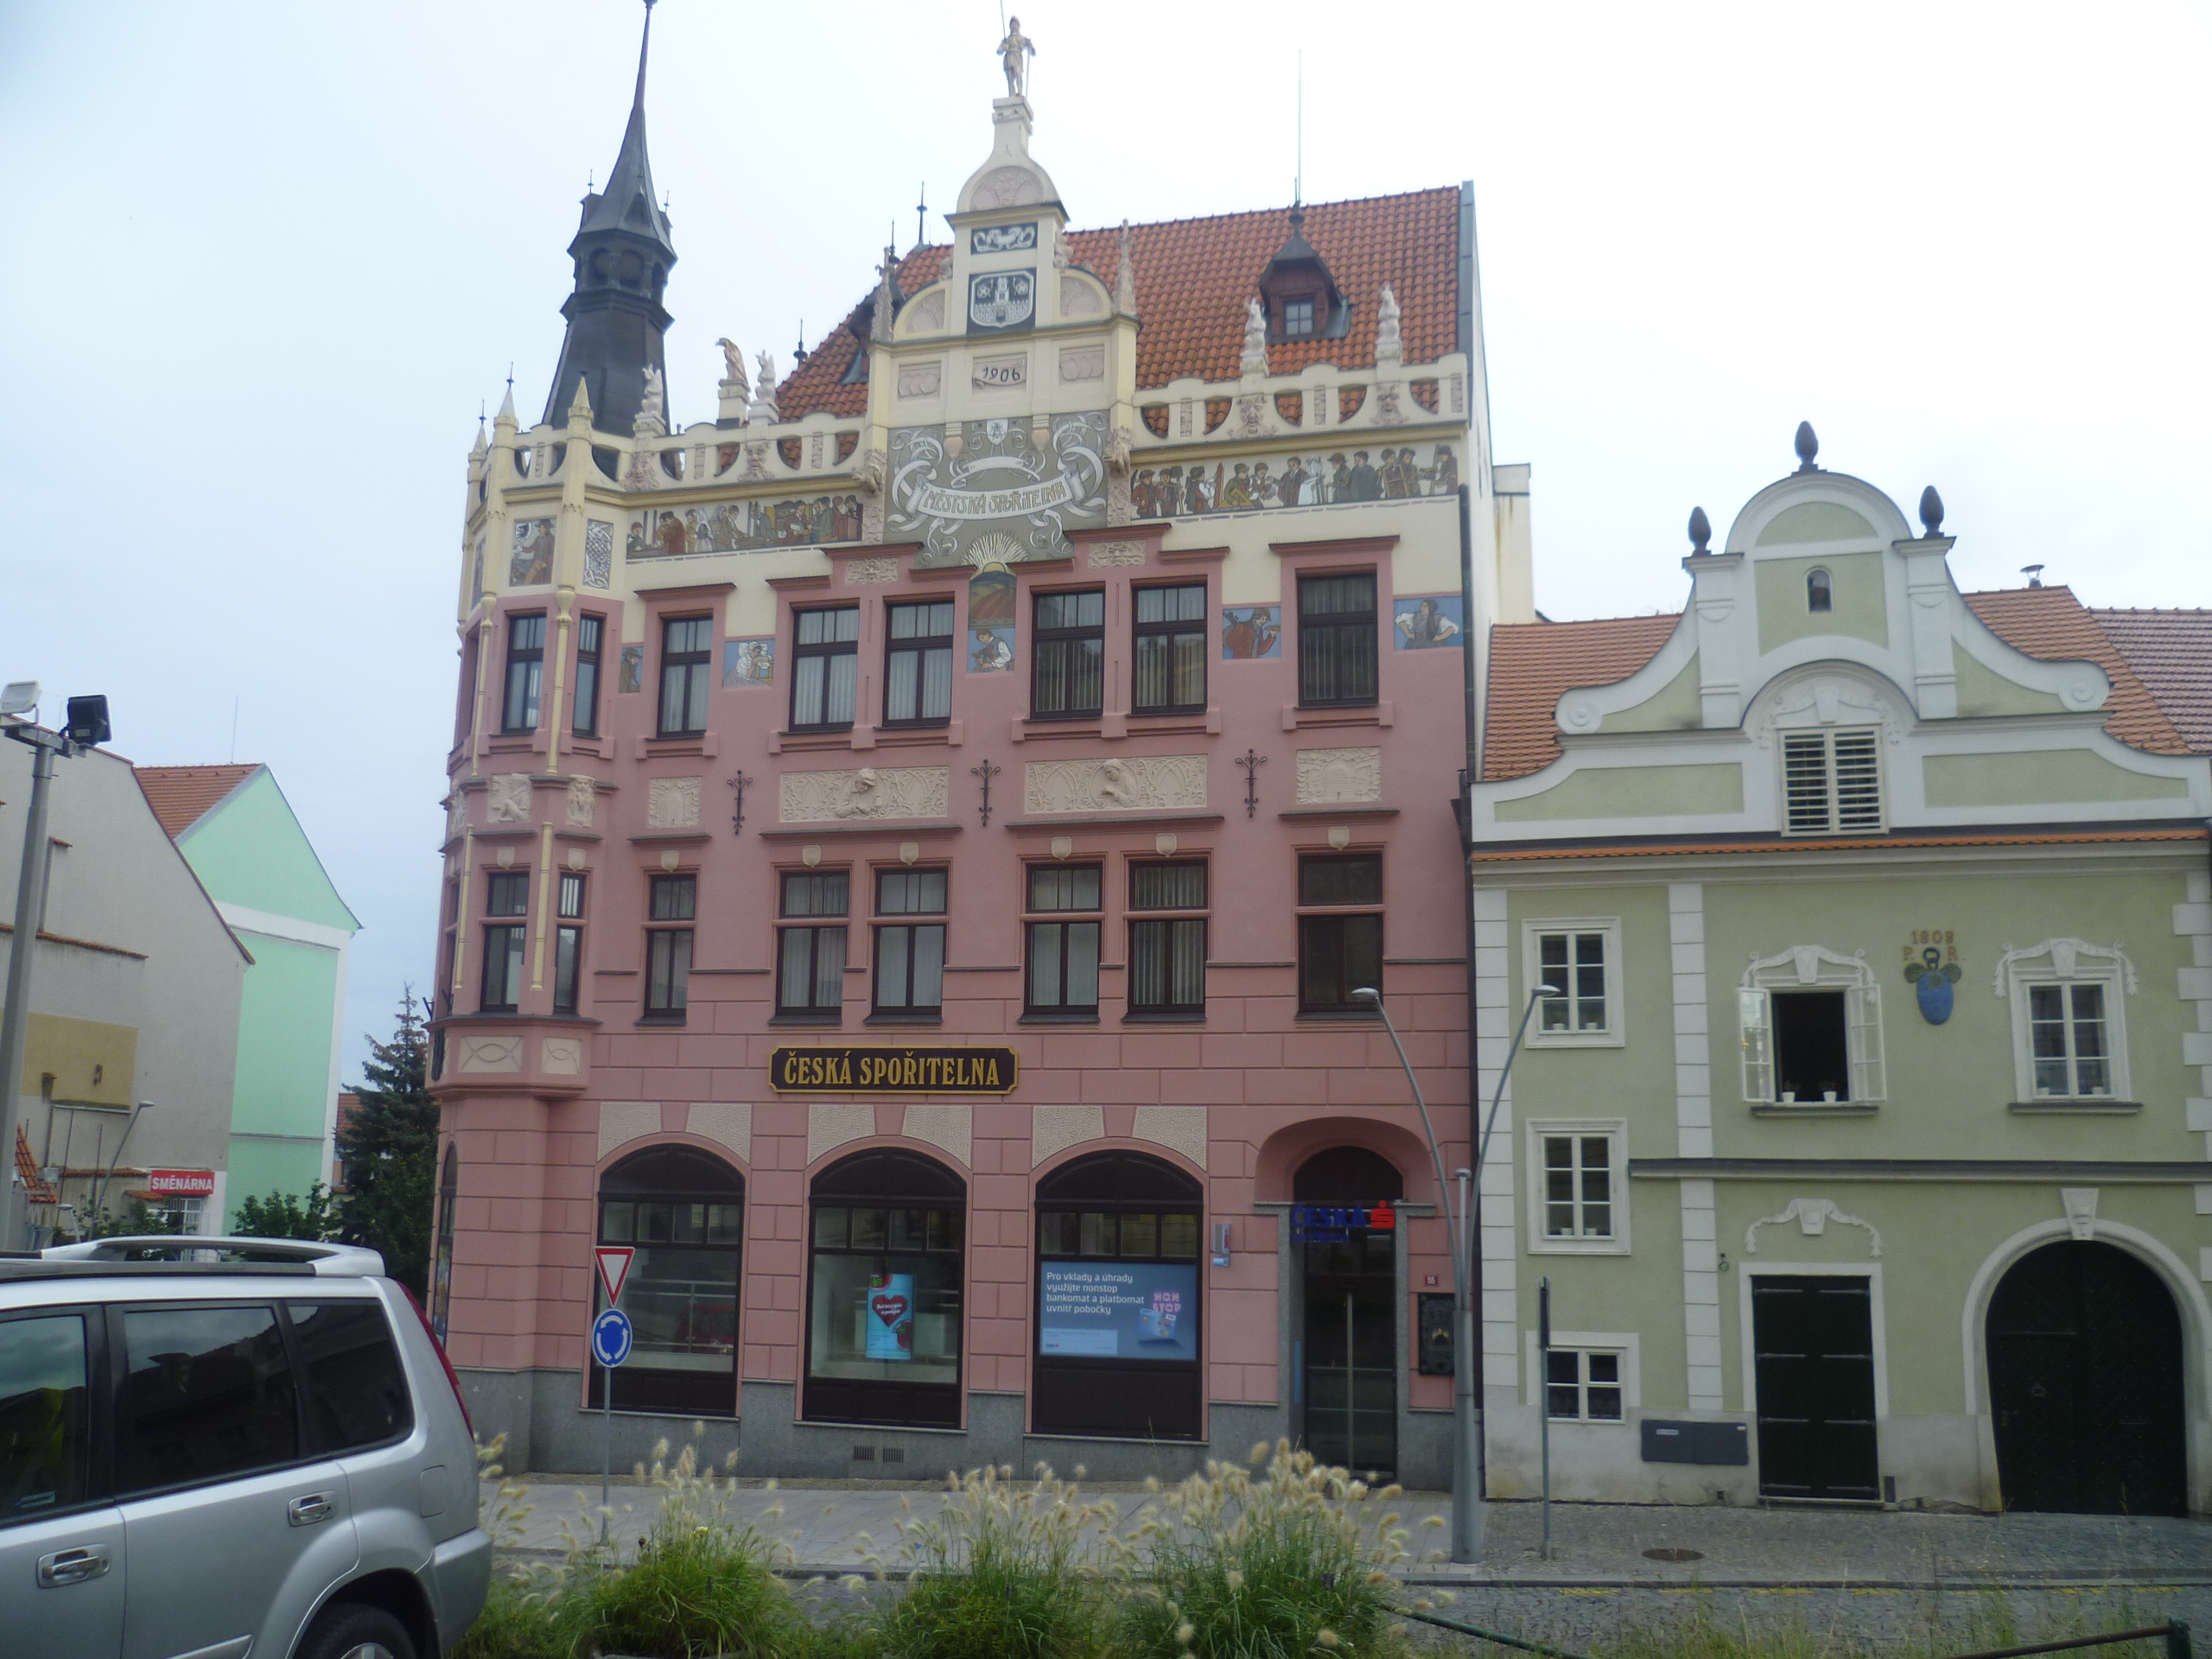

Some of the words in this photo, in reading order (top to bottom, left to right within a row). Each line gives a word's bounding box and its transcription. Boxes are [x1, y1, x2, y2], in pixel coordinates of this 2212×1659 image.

[982, 366, 1020, 382] 1906
[923, 489, 987, 515] MĚSTSKÁ
[784, 1051, 853, 1084] ČESKÁ
[860, 1051, 1000, 1085] SPOŘITELNA
[152, 1175, 213, 1190] SMĚNÁRNA
[1290, 1202, 1366, 1229] ČESKÁ
[1046, 1272, 1062, 1281] Pro
[1063, 1272, 1093, 1282] vklady
[1102, 1274, 1134, 1284] úhrady
[1427, 1276, 1437, 1285] 55
[1046, 1283, 1081, 1293] využijte
[1083, 1284, 1118, 1294] nonstop
[1046, 1294, 1090, 1303] bankomat
[1099, 1294, 1145, 1305] platbomat
[1154, 1292, 1179, 1302] NON
[1046, 1304, 1072, 1313] uvnitř
[1074, 1305, 1111, 1316] pobočky
[1152, 1302, 1181, 1313] STOP
